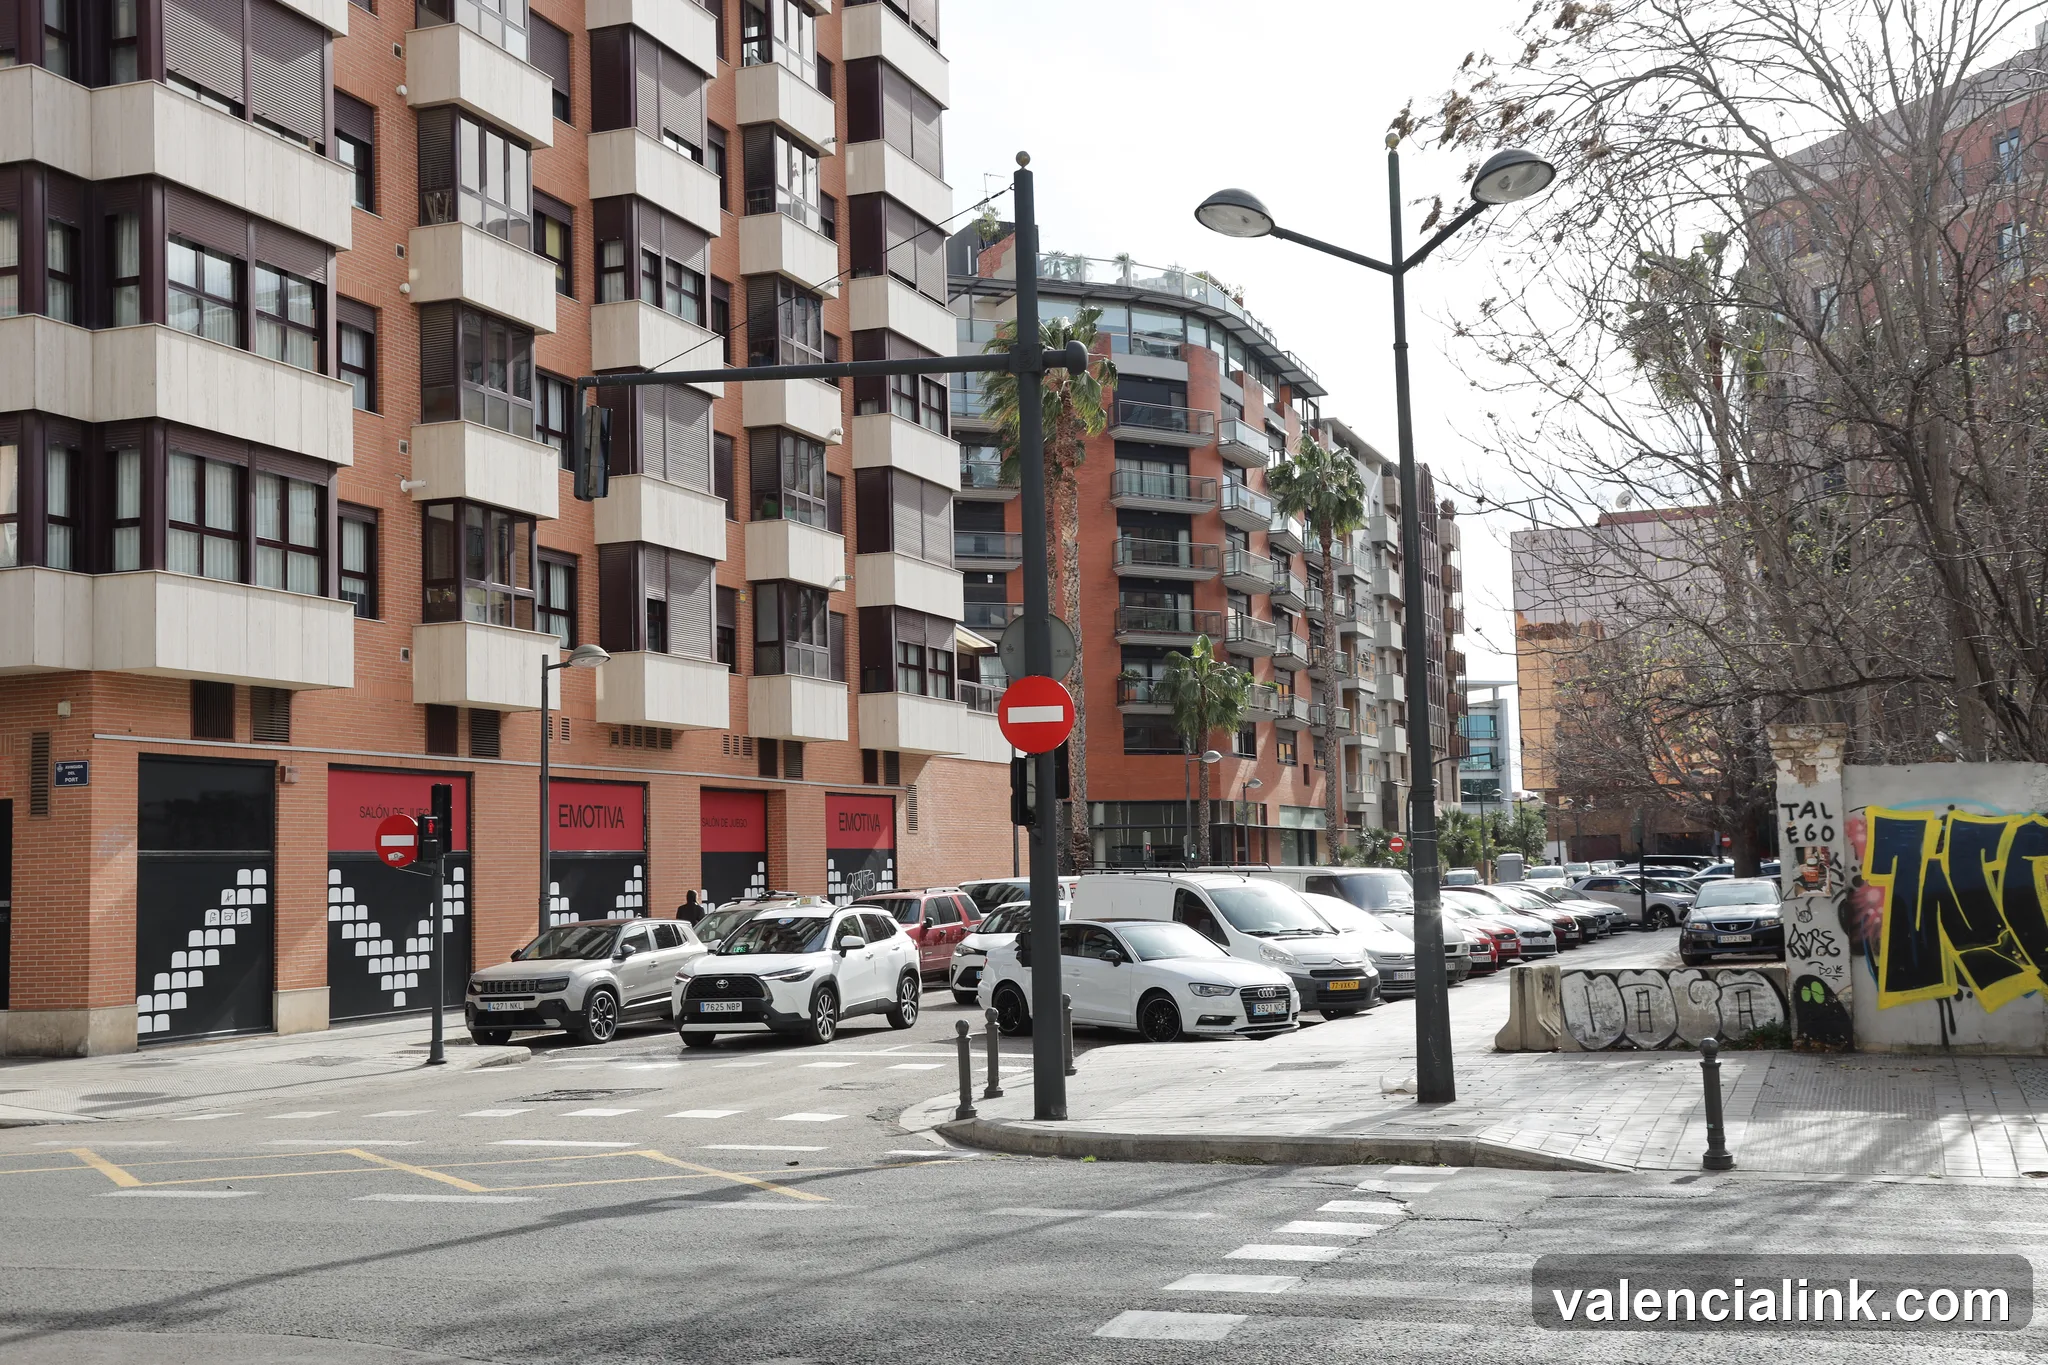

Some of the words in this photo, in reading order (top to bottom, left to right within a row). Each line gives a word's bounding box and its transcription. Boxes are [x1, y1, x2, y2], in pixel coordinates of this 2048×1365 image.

[359, 804, 390, 819] SALÓN
[558, 804, 625, 829] EMOTIVA
[1780, 800, 1833, 821] TAL
[701, 815, 720, 828] SALÓN
[721, 817, 729, 828] DE
[729, 818, 748, 828] JUEGO
[838, 812, 881, 832] EMOTIVA
[1785, 823, 1835, 844] EGO
[510, 1002, 523, 1010] NKL
[705, 1003, 725, 1011] 7625
[726, 1002, 741, 1011] NBP
[1257, 1004, 1273, 1012] 5921
